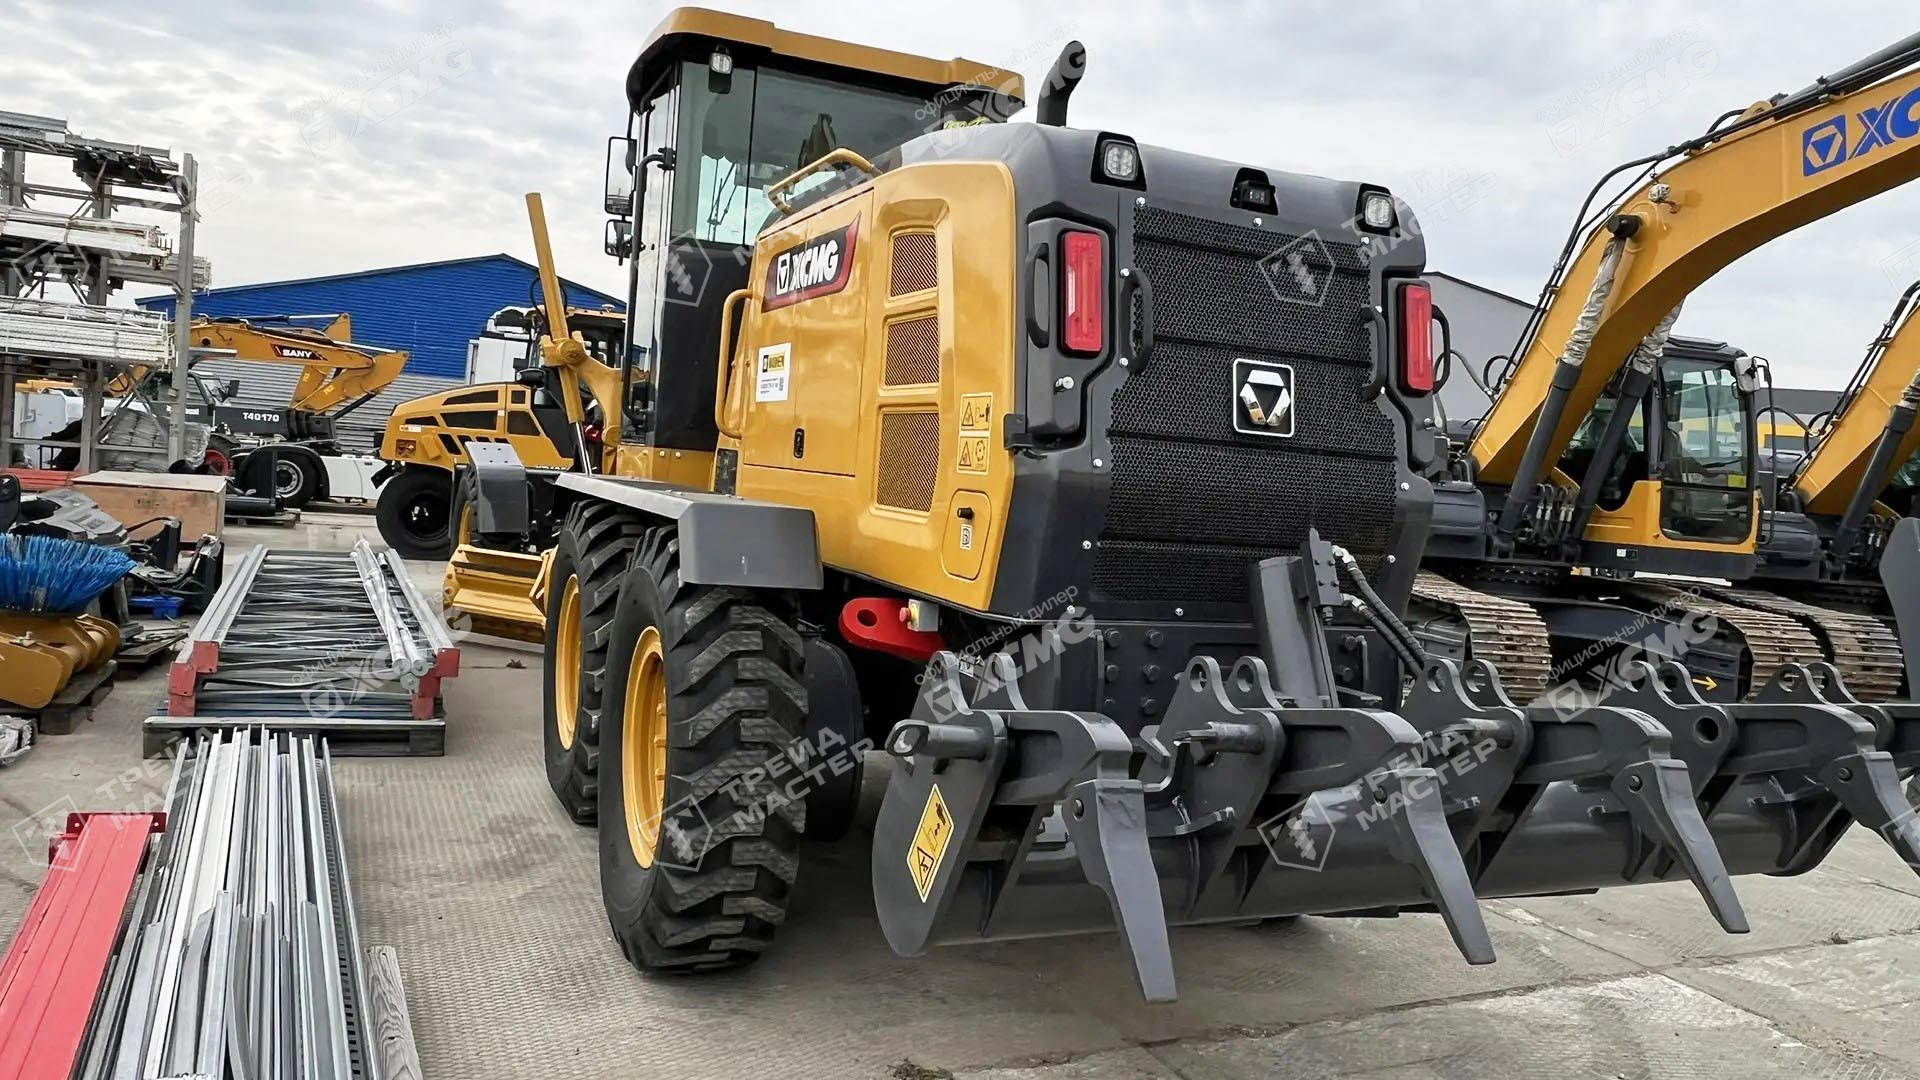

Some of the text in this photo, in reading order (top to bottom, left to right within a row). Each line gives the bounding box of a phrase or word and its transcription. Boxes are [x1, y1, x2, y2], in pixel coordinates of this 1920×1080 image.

[790, 240, 839, 291] XCMG
[282, 349, 312, 358] SANY
[243, 412, 280, 422] T40170
